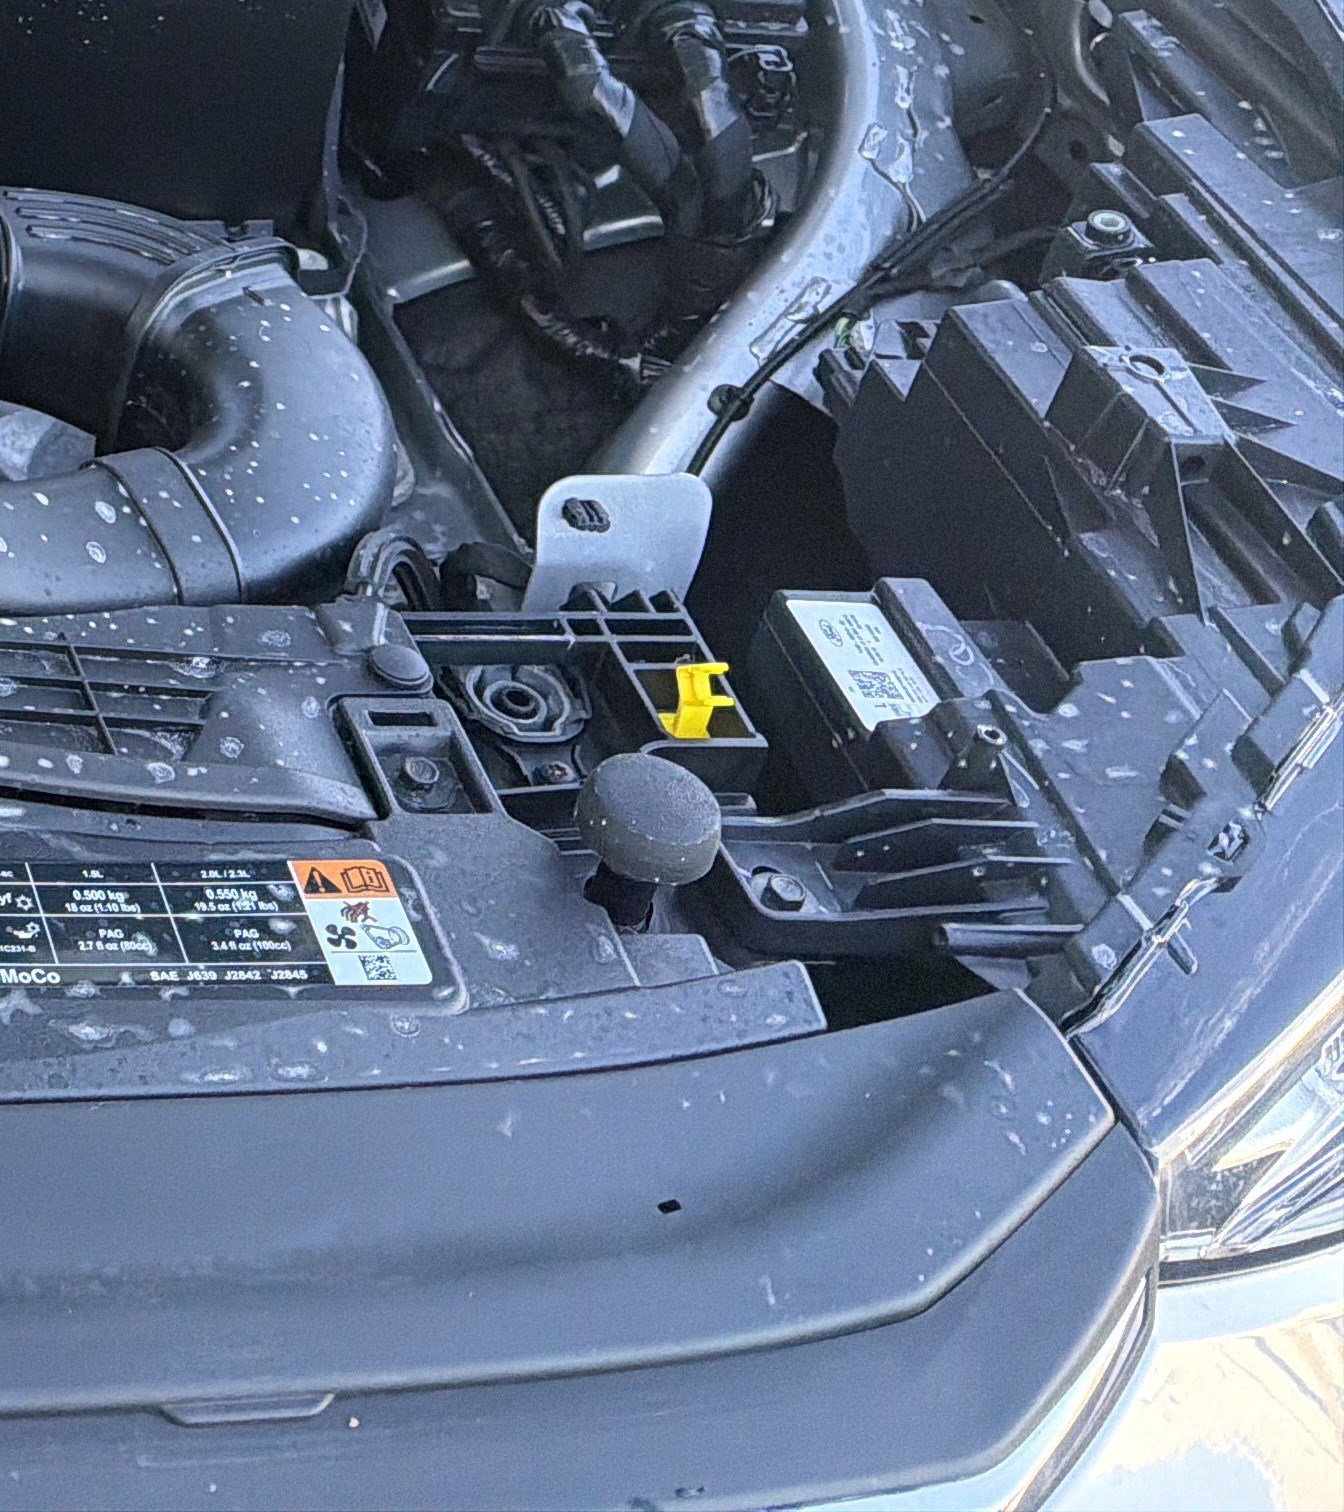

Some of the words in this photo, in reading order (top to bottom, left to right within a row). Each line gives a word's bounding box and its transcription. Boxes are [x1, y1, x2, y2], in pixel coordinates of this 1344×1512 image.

[72, 889, 106, 901] 0.500
[107, 889, 125, 903] kg
[204, 888, 239, 900] 0.550
[240, 888, 258, 902] kg
[79, 904, 94, 912] oz
[217, 903, 231, 911] oz
[98, 928, 125, 939] PAG
[234, 928, 259, 939] PAG
[77, 940, 94, 951] 2.7
[105, 943, 119, 951] oz
[238, 942, 252, 951] oz
[253, 940, 292, 952] (100cc)
[150, 970, 180, 981] SAE
[186, 970, 217, 981] J639
[224, 969, 261, 981] J2842
[270, 969, 309, 980] J2845
